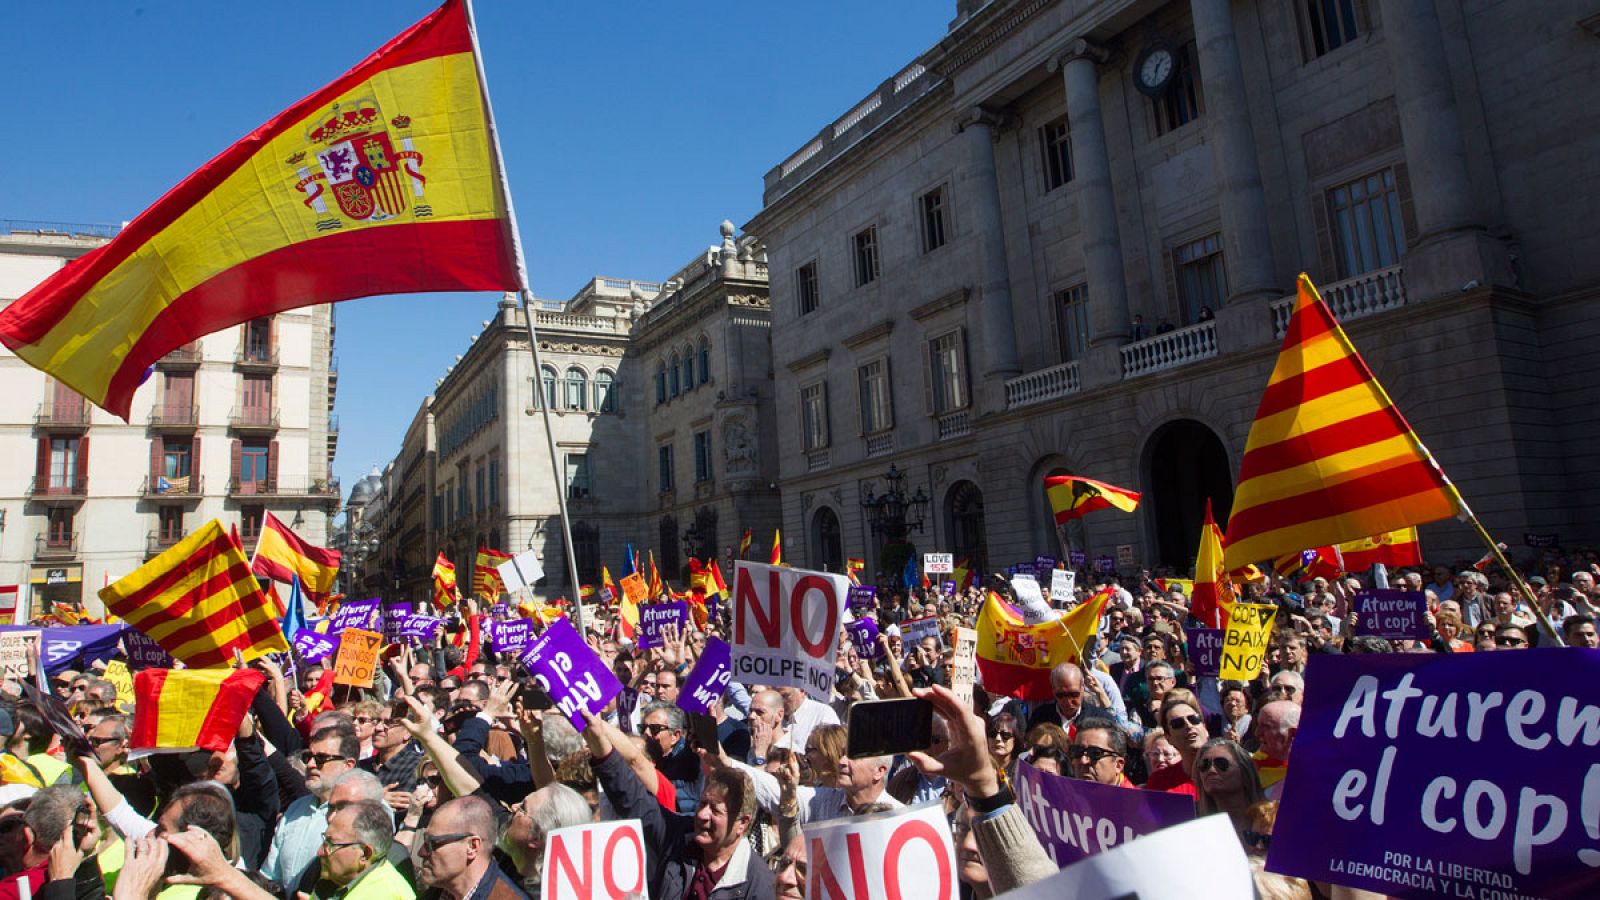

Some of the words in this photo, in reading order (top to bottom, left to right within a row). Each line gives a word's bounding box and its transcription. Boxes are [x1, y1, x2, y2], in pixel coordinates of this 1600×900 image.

[339, 604, 372, 616] Aturem
[735, 568, 838, 659] NO
[1232, 605, 1257, 624] COP
[1361, 598, 1417, 613] Aturem
[346, 612, 368, 627] cop!
[644, 607, 681, 623] Aturem
[496, 624, 528, 635] Aturem
[647, 621, 656, 636] el
[1367, 617, 1380, 629] el
[1384, 616, 1416, 634] cop!
[498, 634, 507, 645] el
[508, 631, 528, 645] cop!
[1200, 651, 1214, 666] el
[1223, 652, 1263, 673] NO!
[809, 666, 832, 695] NO!
[1332, 745, 1397, 825] el
[548, 825, 644, 900] NO
[811, 819, 951, 900] NO
[1384, 851, 1411, 869] POR
[1416, 857, 1434, 872] LA
[1329, 858, 1344, 872] LA
[1347, 862, 1436, 890] DEMOCRACIA
[1440, 879, 1450, 894] Y
[1455, 882, 1474, 899] LA
